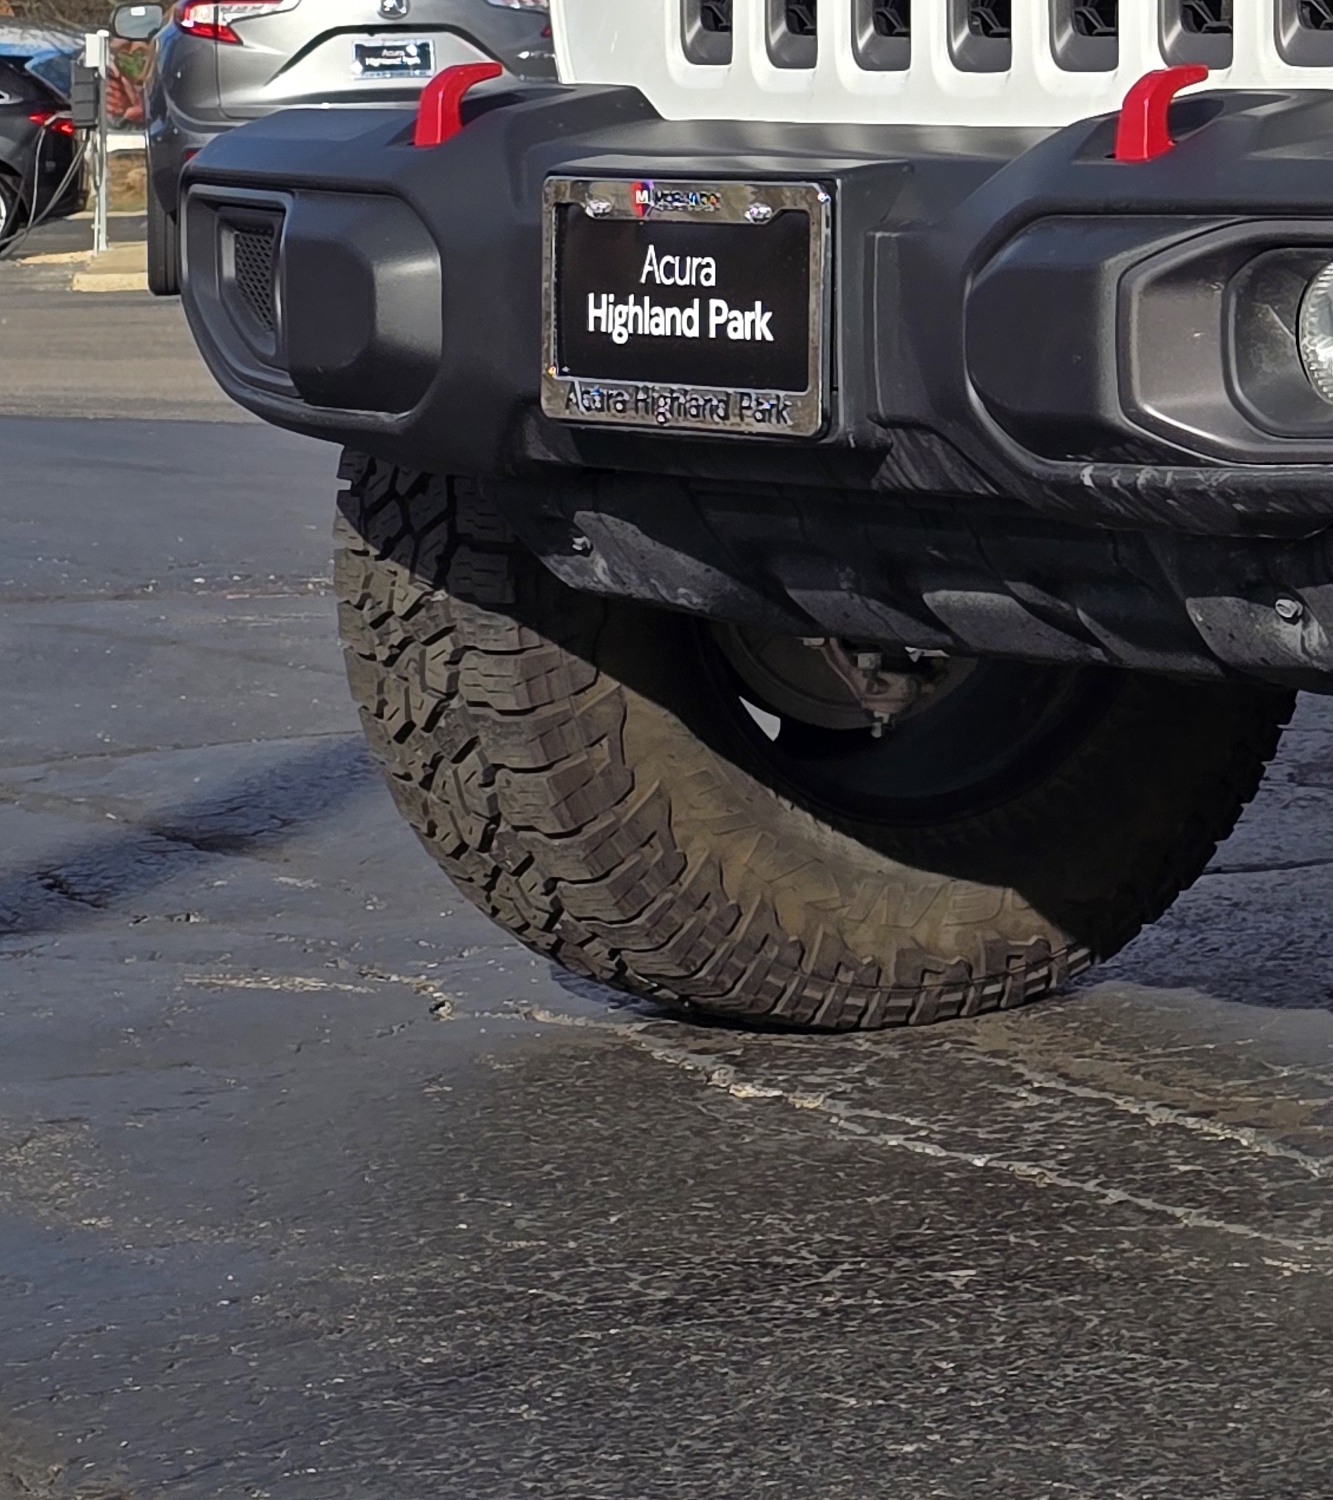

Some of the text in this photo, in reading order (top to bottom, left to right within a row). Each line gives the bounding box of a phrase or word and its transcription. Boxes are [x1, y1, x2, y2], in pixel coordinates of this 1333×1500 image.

[639, 245, 716, 287] Acura
[587, 293, 774, 344] Highland Park
[567, 381, 793, 426] Acura Highland Park
